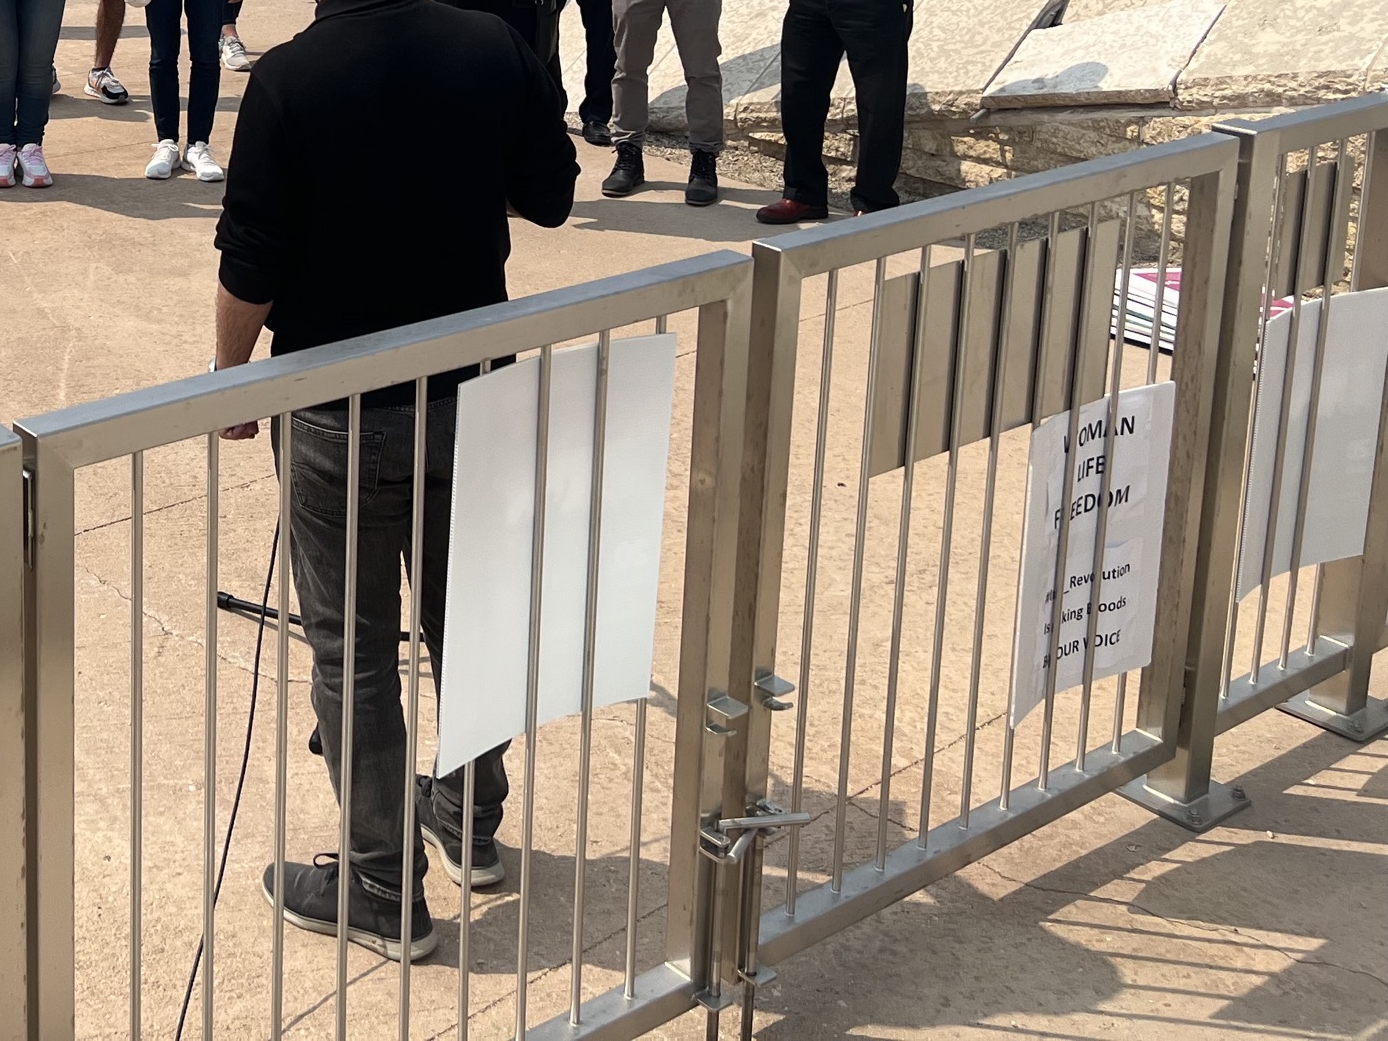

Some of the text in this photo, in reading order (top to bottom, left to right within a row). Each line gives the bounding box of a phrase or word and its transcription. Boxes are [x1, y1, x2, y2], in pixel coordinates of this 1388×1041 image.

[1077, 455, 1106, 482] LIFE
[1054, 485, 1130, 529] FEEDOM
[1086, 596, 1126, 615] Boods
